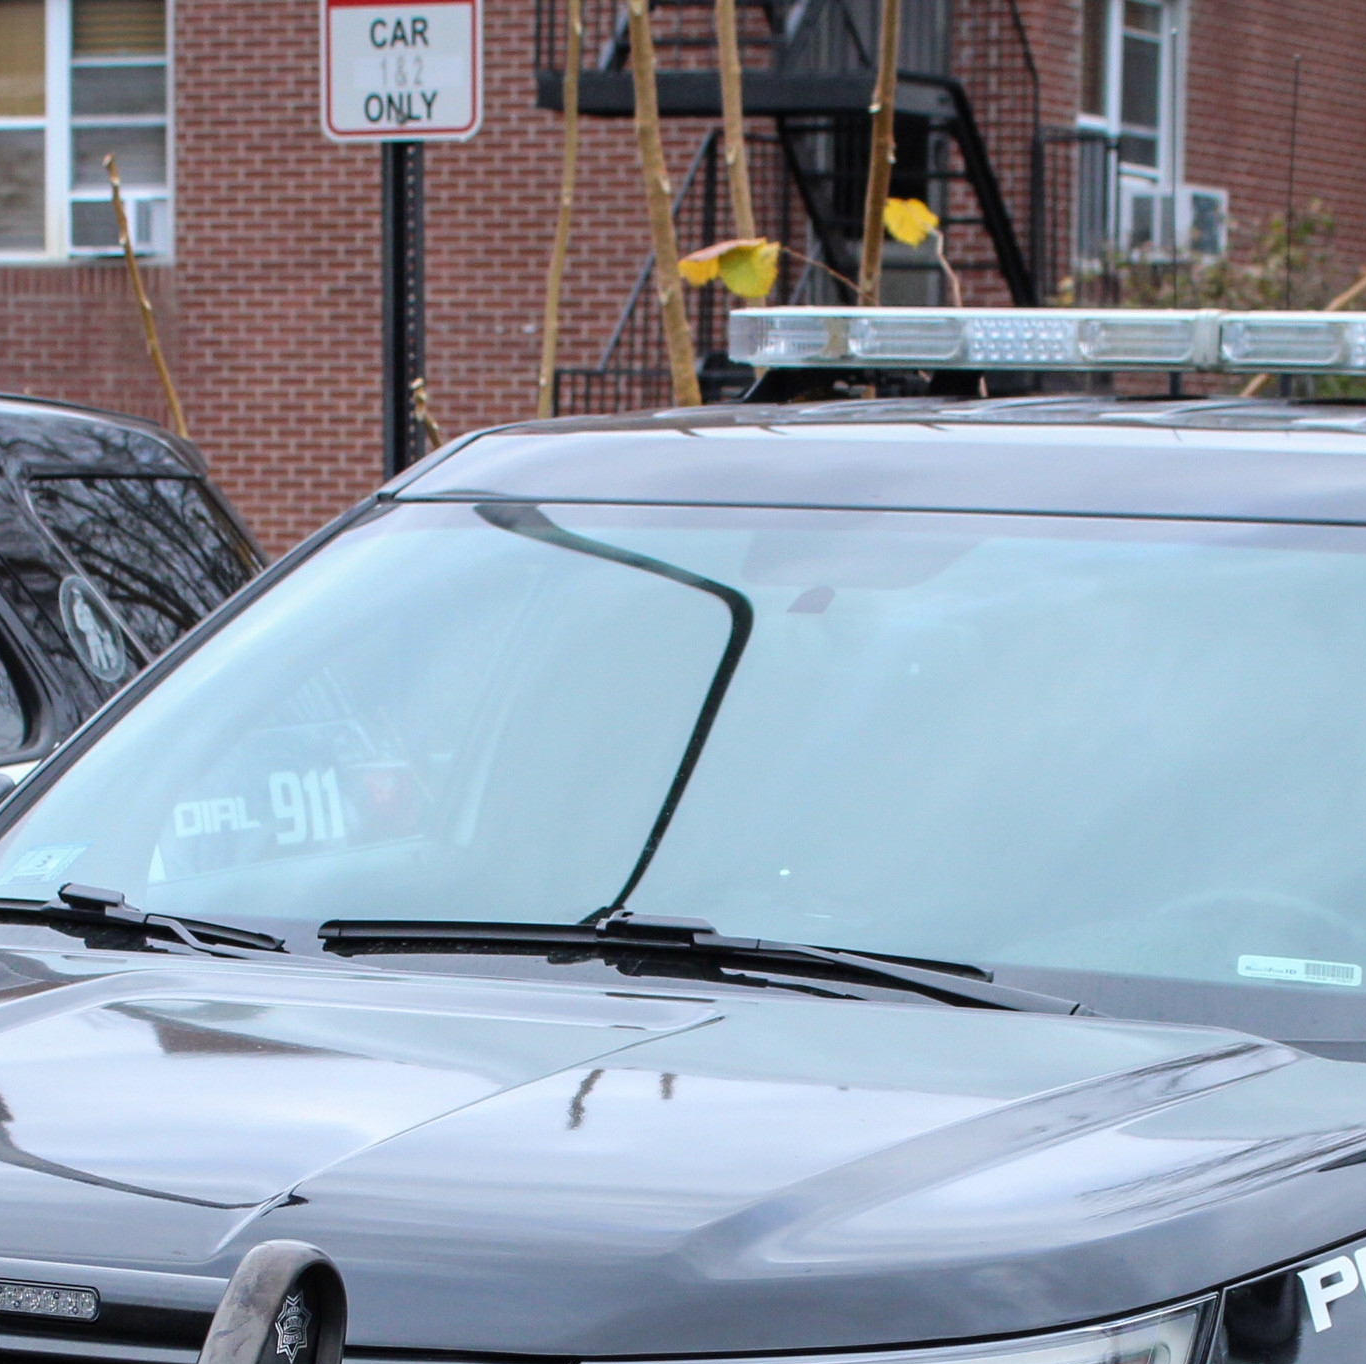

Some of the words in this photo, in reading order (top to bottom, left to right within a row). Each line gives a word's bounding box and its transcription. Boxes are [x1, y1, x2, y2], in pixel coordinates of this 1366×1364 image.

[370, 17, 430, 48] CAR
[364, 90, 438, 123] ONLY
[172, 796, 262, 838] DIAL
[268, 767, 346, 845] 911
